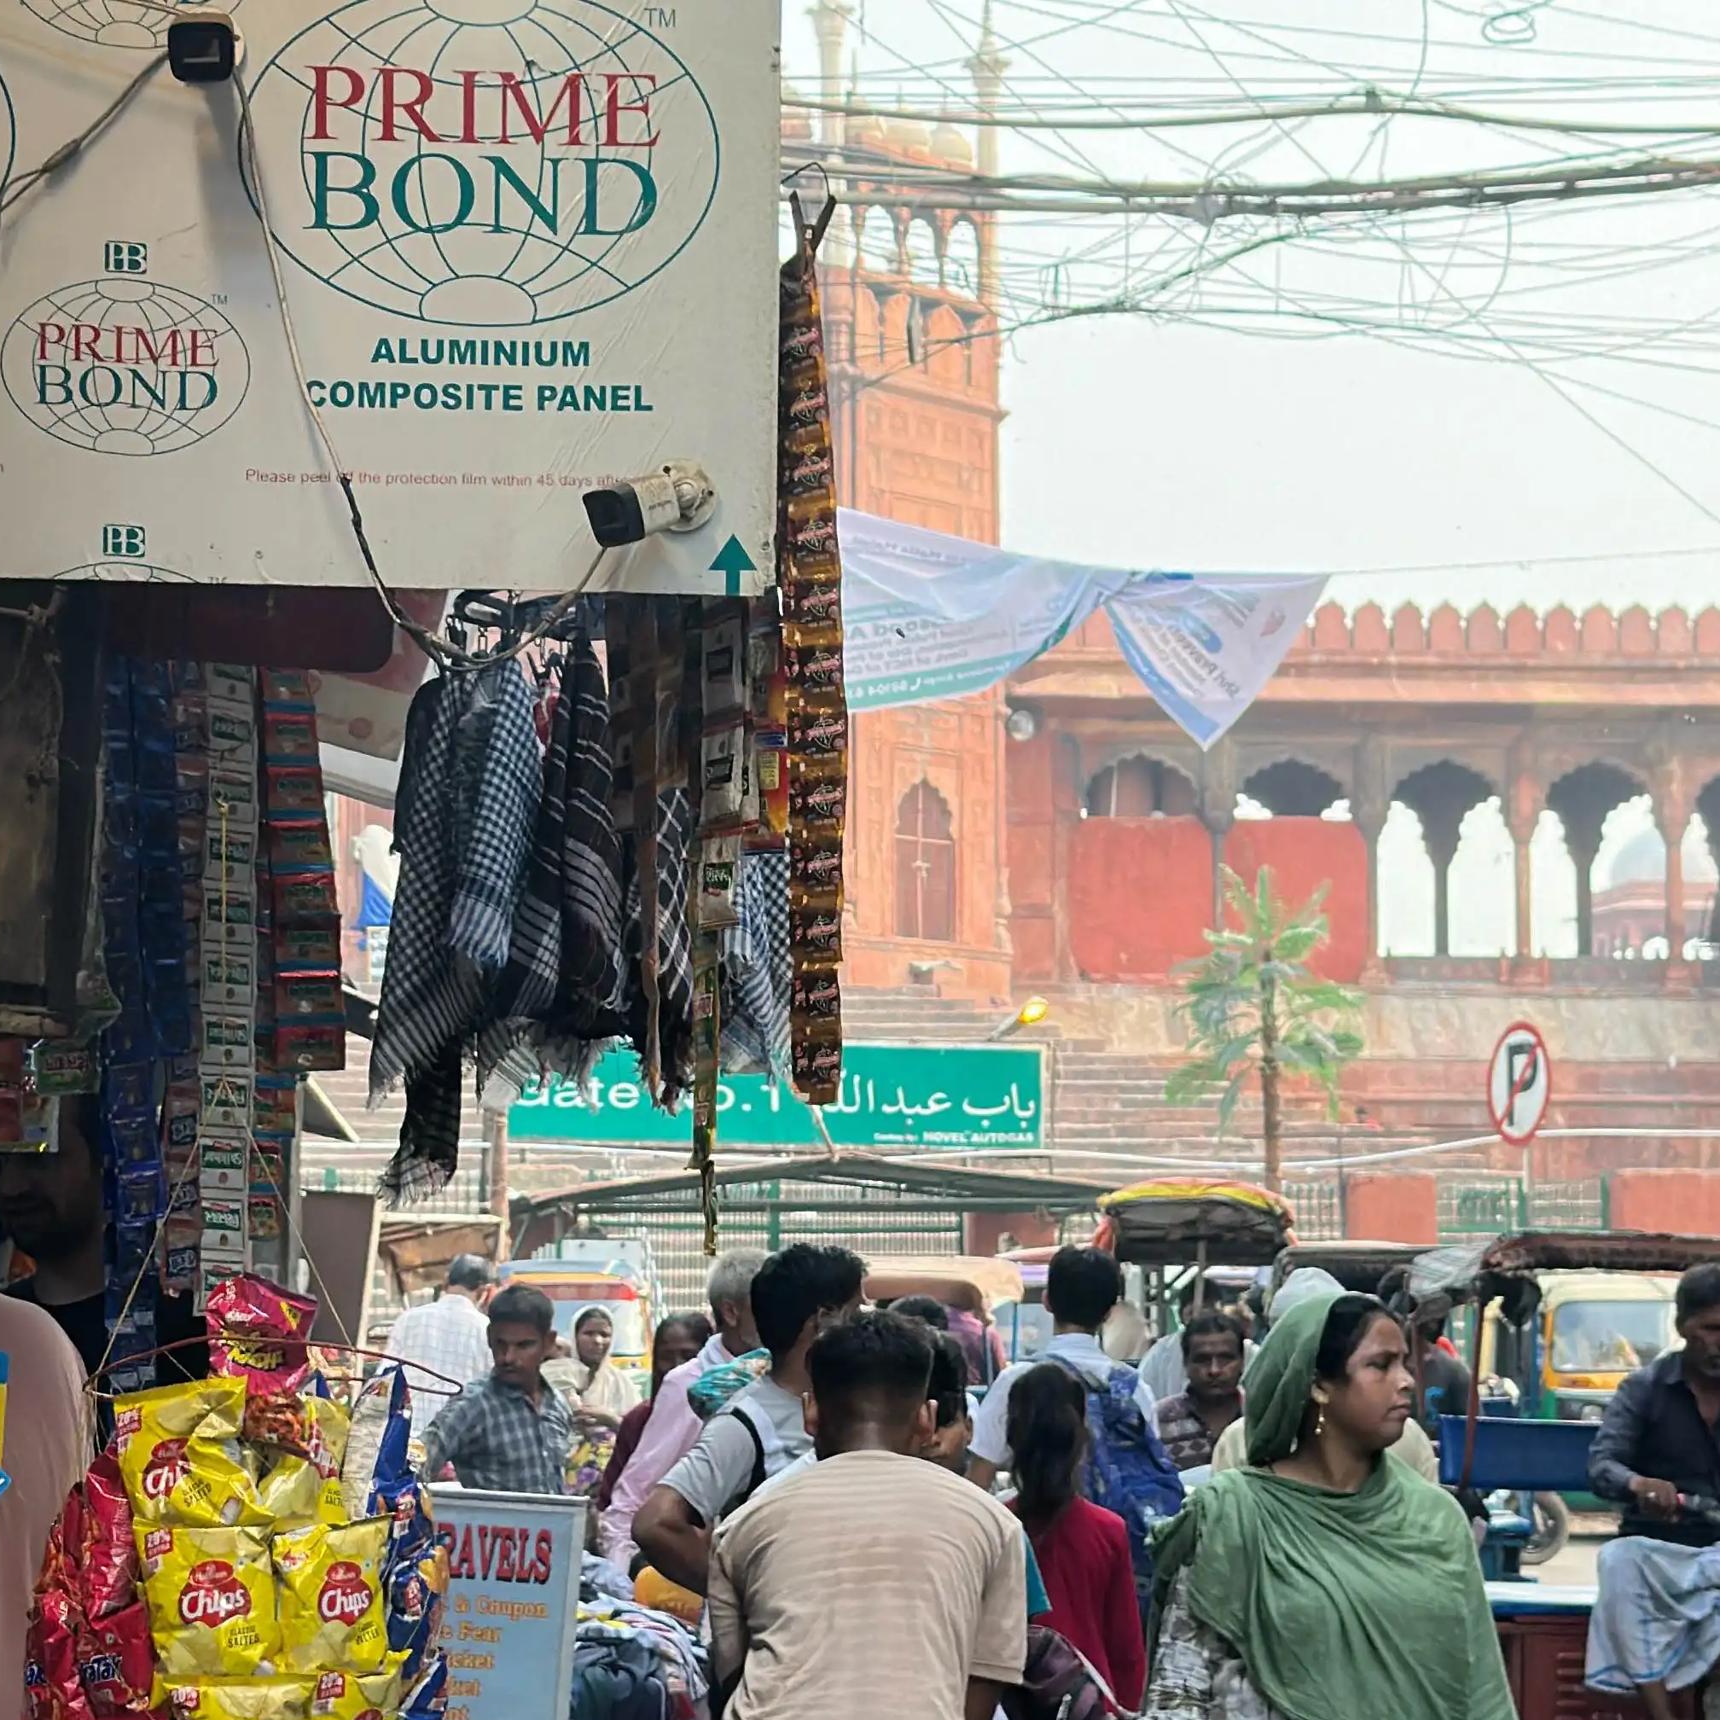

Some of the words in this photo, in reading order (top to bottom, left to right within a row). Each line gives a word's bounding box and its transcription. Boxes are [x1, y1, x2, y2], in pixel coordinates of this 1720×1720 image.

[304, 65, 662, 148] PRIME
[303, 151, 659, 237] BOND
[35, 322, 220, 368] PRIME
[371, 337, 591, 367] ALUMINIUM
[34, 364, 219, 411] BOND
[306, 380, 524, 412] COMPOSITE
[537, 382, 654, 413] PANEL
[245, 469, 296, 484] Please
[300, 471, 332, 488] peel
[359, 471, 382, 486] the
[385, 472, 458, 490] protection
[462, 473, 488, 487] film
[492, 474, 533, 488] within
[536, 475, 555, 488] 45
[559, 474, 593, 491] days
[1506, 1040, 1538, 1127] P
[962, 1088, 1036, 1129] باب
[446, 1524, 553, 1584] RAVELS
[320, 1589, 370, 1618] Chips
[475, 1597, 549, 1620] Coupon
